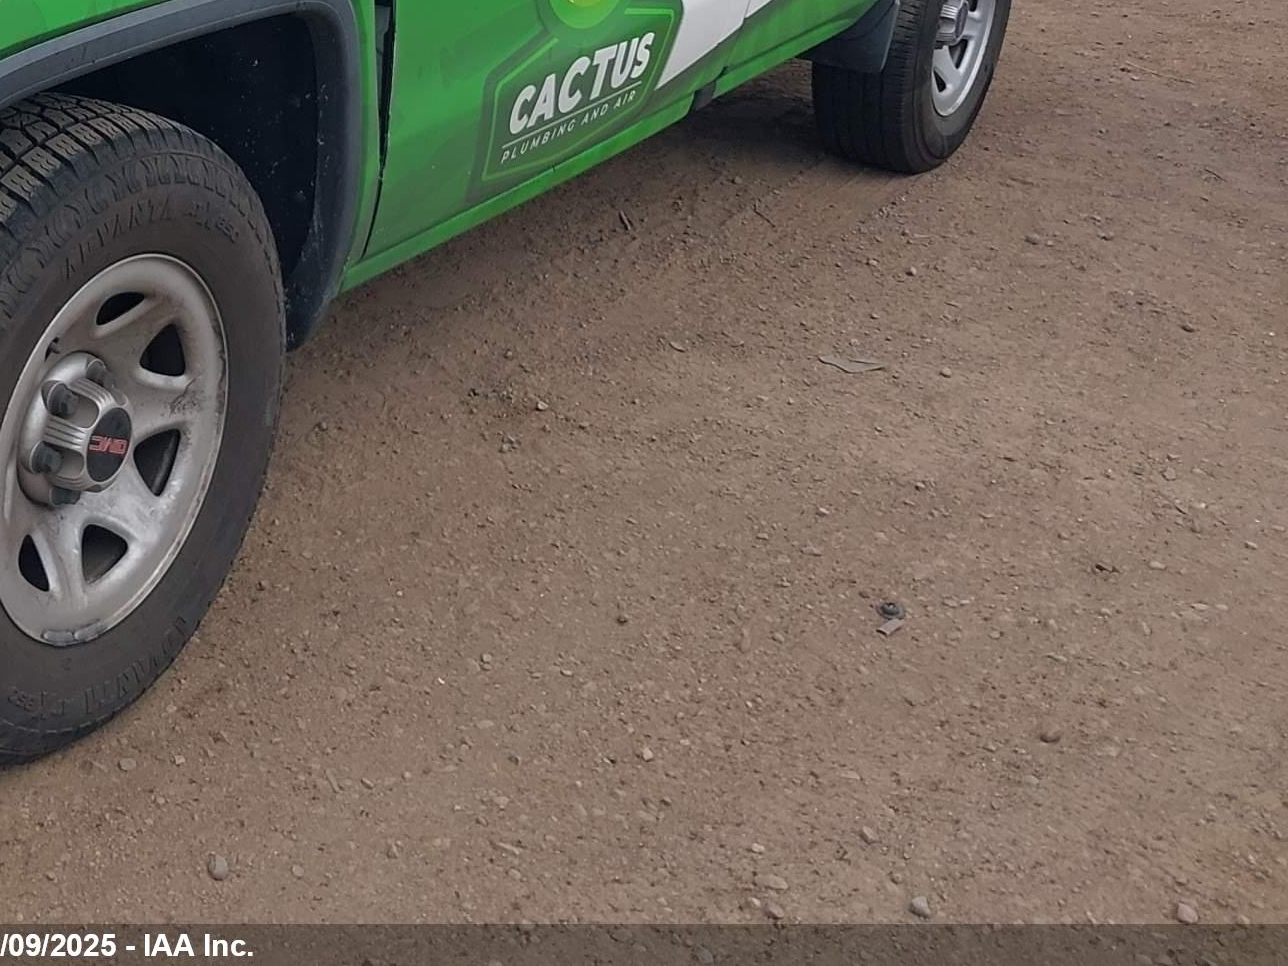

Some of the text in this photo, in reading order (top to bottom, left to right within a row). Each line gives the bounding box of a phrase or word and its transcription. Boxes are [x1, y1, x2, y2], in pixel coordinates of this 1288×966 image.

[500, 89, 637, 164] PLUMBING AND AIR
[509, 32, 655, 134] CACTUS
